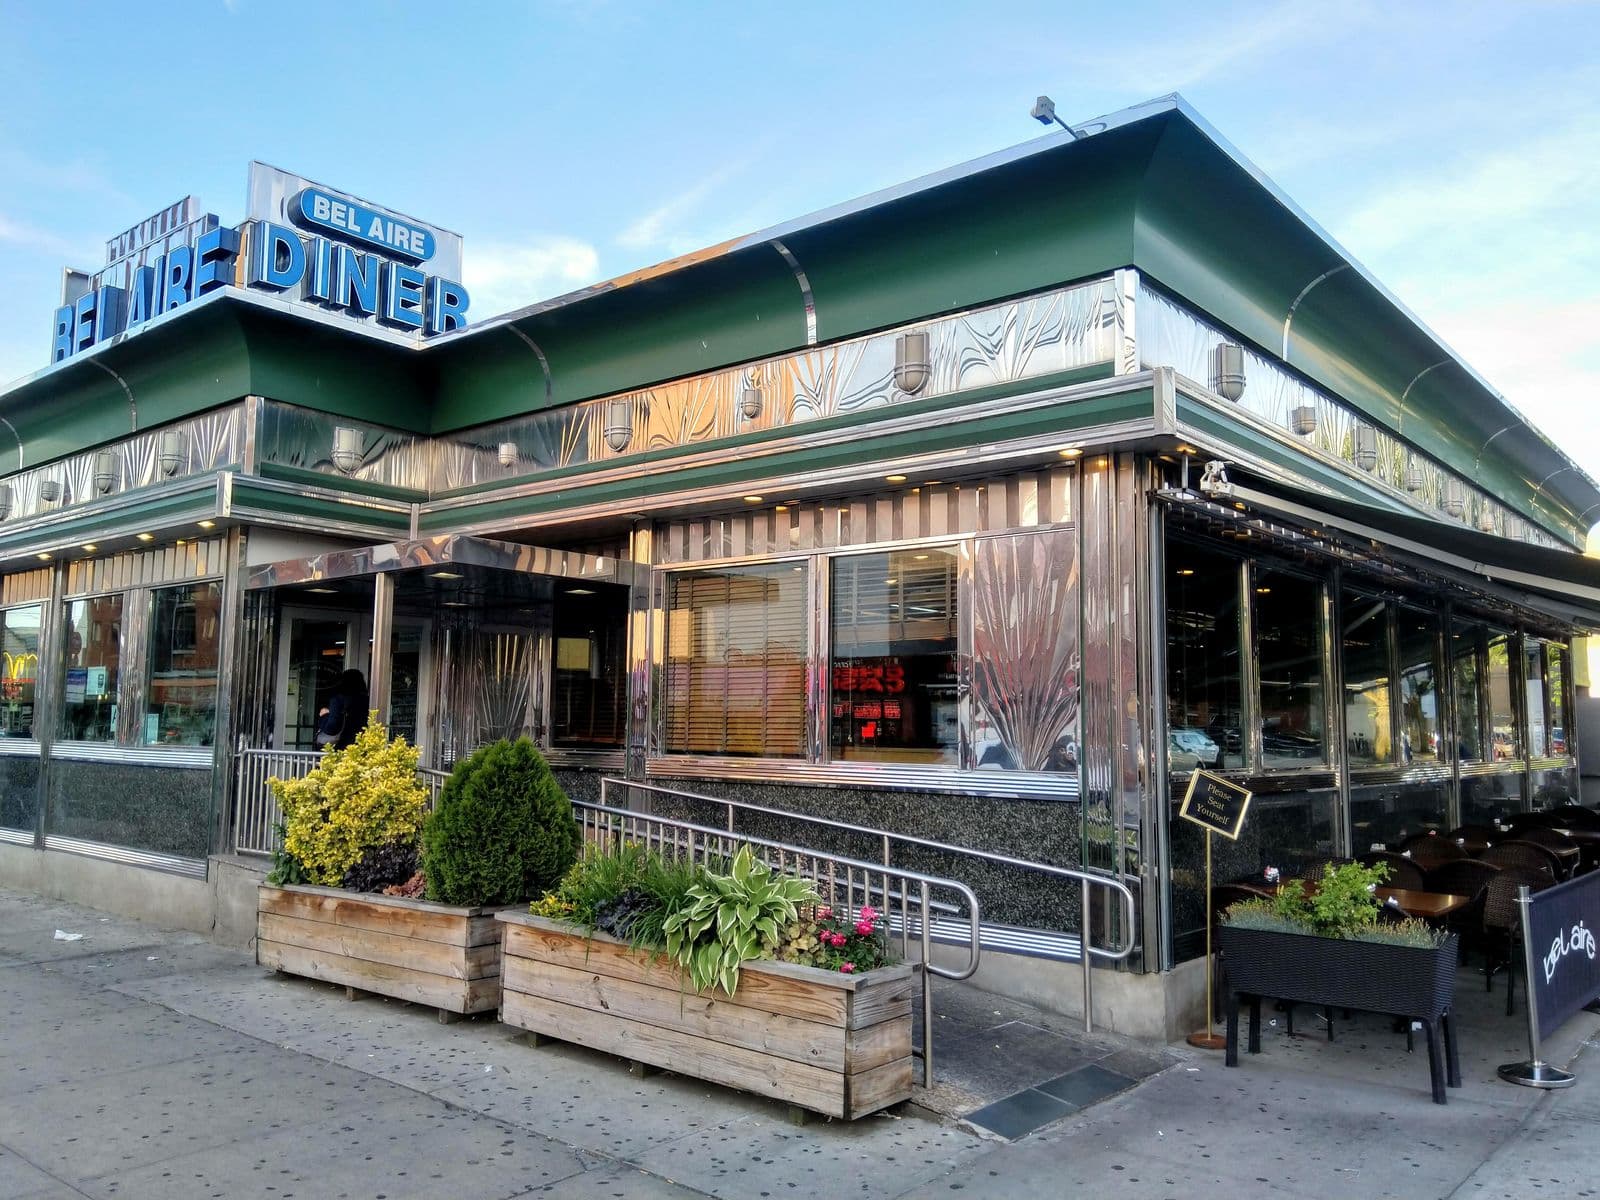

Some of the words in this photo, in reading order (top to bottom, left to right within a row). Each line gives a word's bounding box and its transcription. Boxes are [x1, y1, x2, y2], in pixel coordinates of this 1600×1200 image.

[313, 194, 361, 233] BEL
[368, 216, 425, 256] AIRE
[126, 227, 236, 331] AIRE
[257, 220, 470, 334] DINER
[1207, 783, 1232, 801] Please
[1207, 796, 1225, 811] Seat
[1196, 803, 1230, 825] Yourself
[1570, 919, 1596, 959] aire
